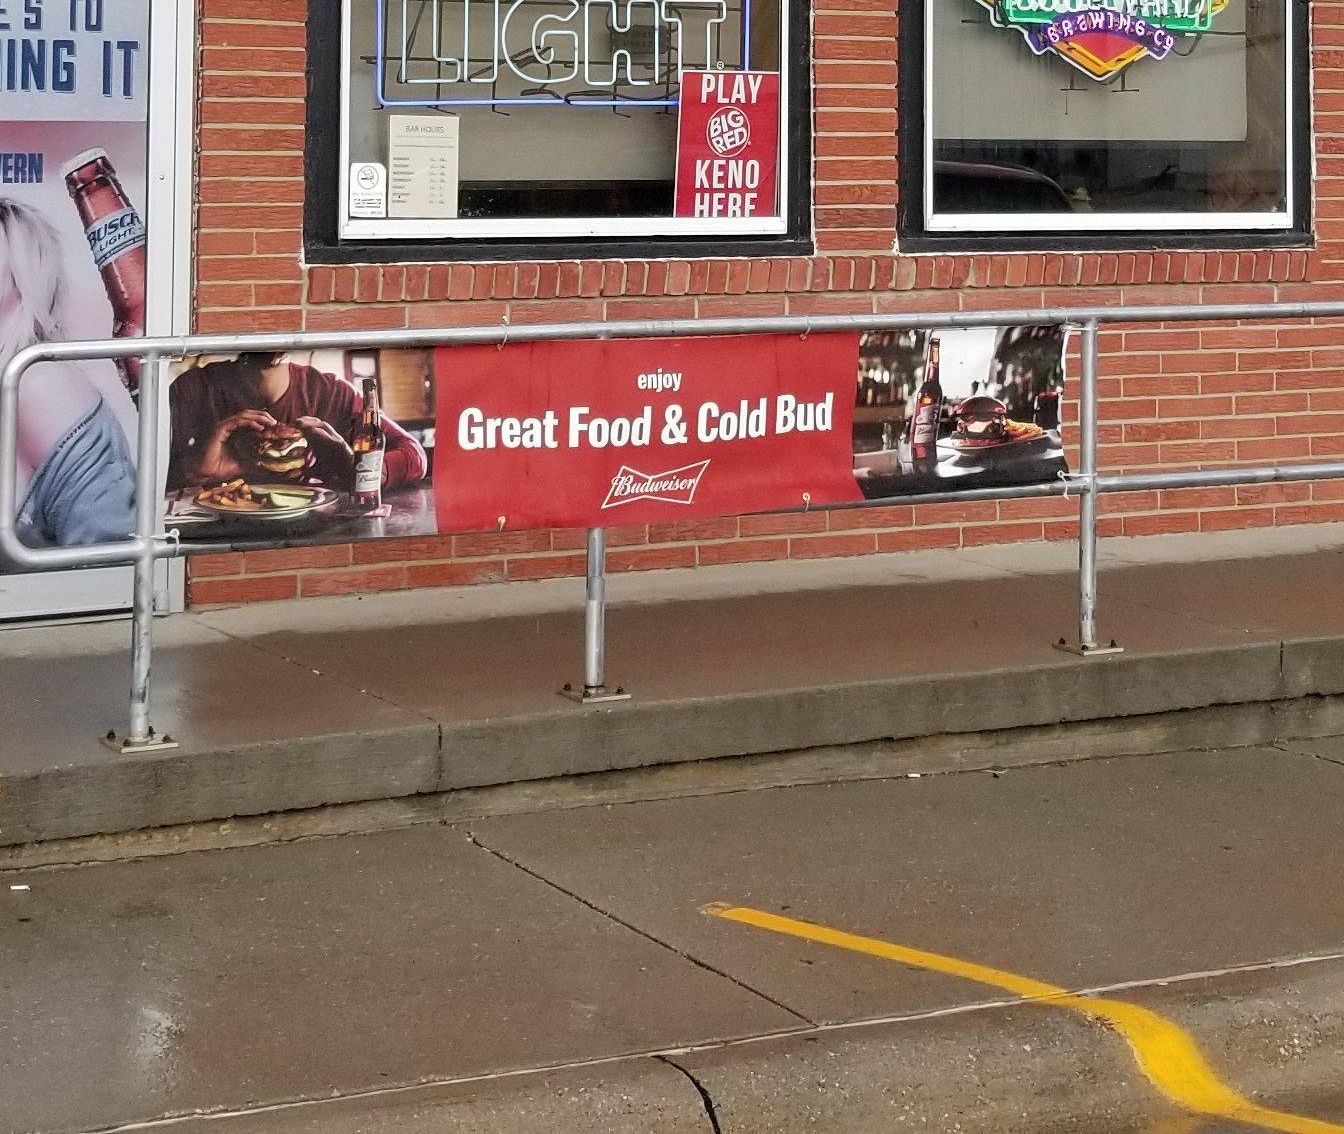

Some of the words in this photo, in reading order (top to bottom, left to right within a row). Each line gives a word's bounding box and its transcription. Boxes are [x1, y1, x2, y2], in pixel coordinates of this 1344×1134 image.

[1047, 12, 1146, 42] BREWING
[102, 40, 139, 99] IT
[701, 74, 763, 103] PLAY
[710, 110, 744, 137] BIG
[711, 127, 748, 154] RED
[694, 159, 760, 189] KENO
[694, 192, 758, 218] HERE
[99, 227, 134, 252] LIGHT
[637, 369, 682, 393] enjoy
[458, 407, 558, 450] Great
[568, 406, 652, 447] Food
[660, 404, 688, 445] &
[697, 398, 767, 443] Cold
[776, 393, 834, 435] Bud
[611, 474, 696, 496] Budweiser
